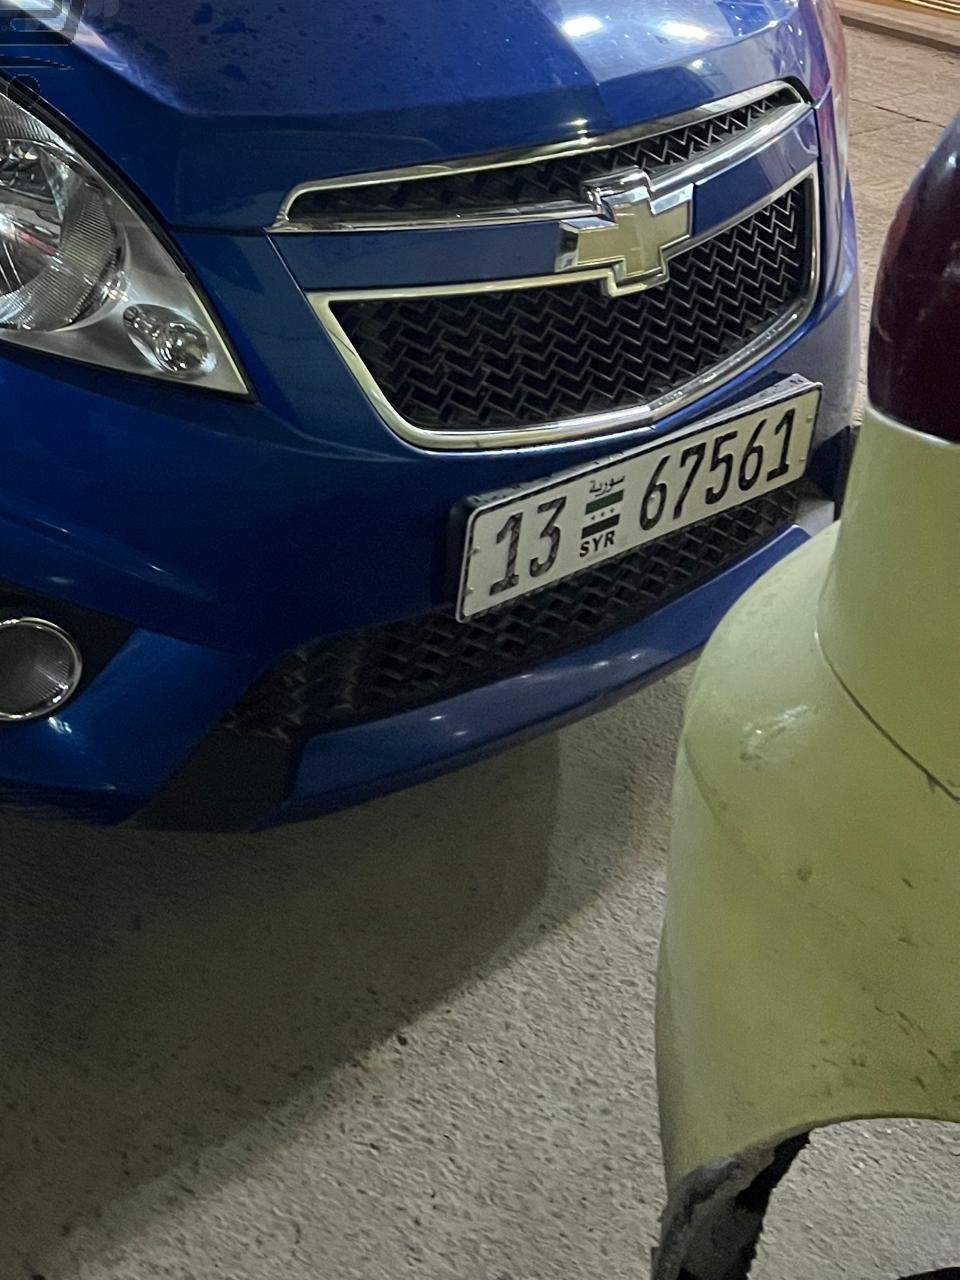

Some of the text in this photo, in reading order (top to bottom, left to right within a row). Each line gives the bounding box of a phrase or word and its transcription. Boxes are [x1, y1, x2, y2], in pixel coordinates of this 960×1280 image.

[589, 474, 626, 499] سورية
[489, 407, 796, 596] 13 67561
[578, 530, 615, 558] SYR
